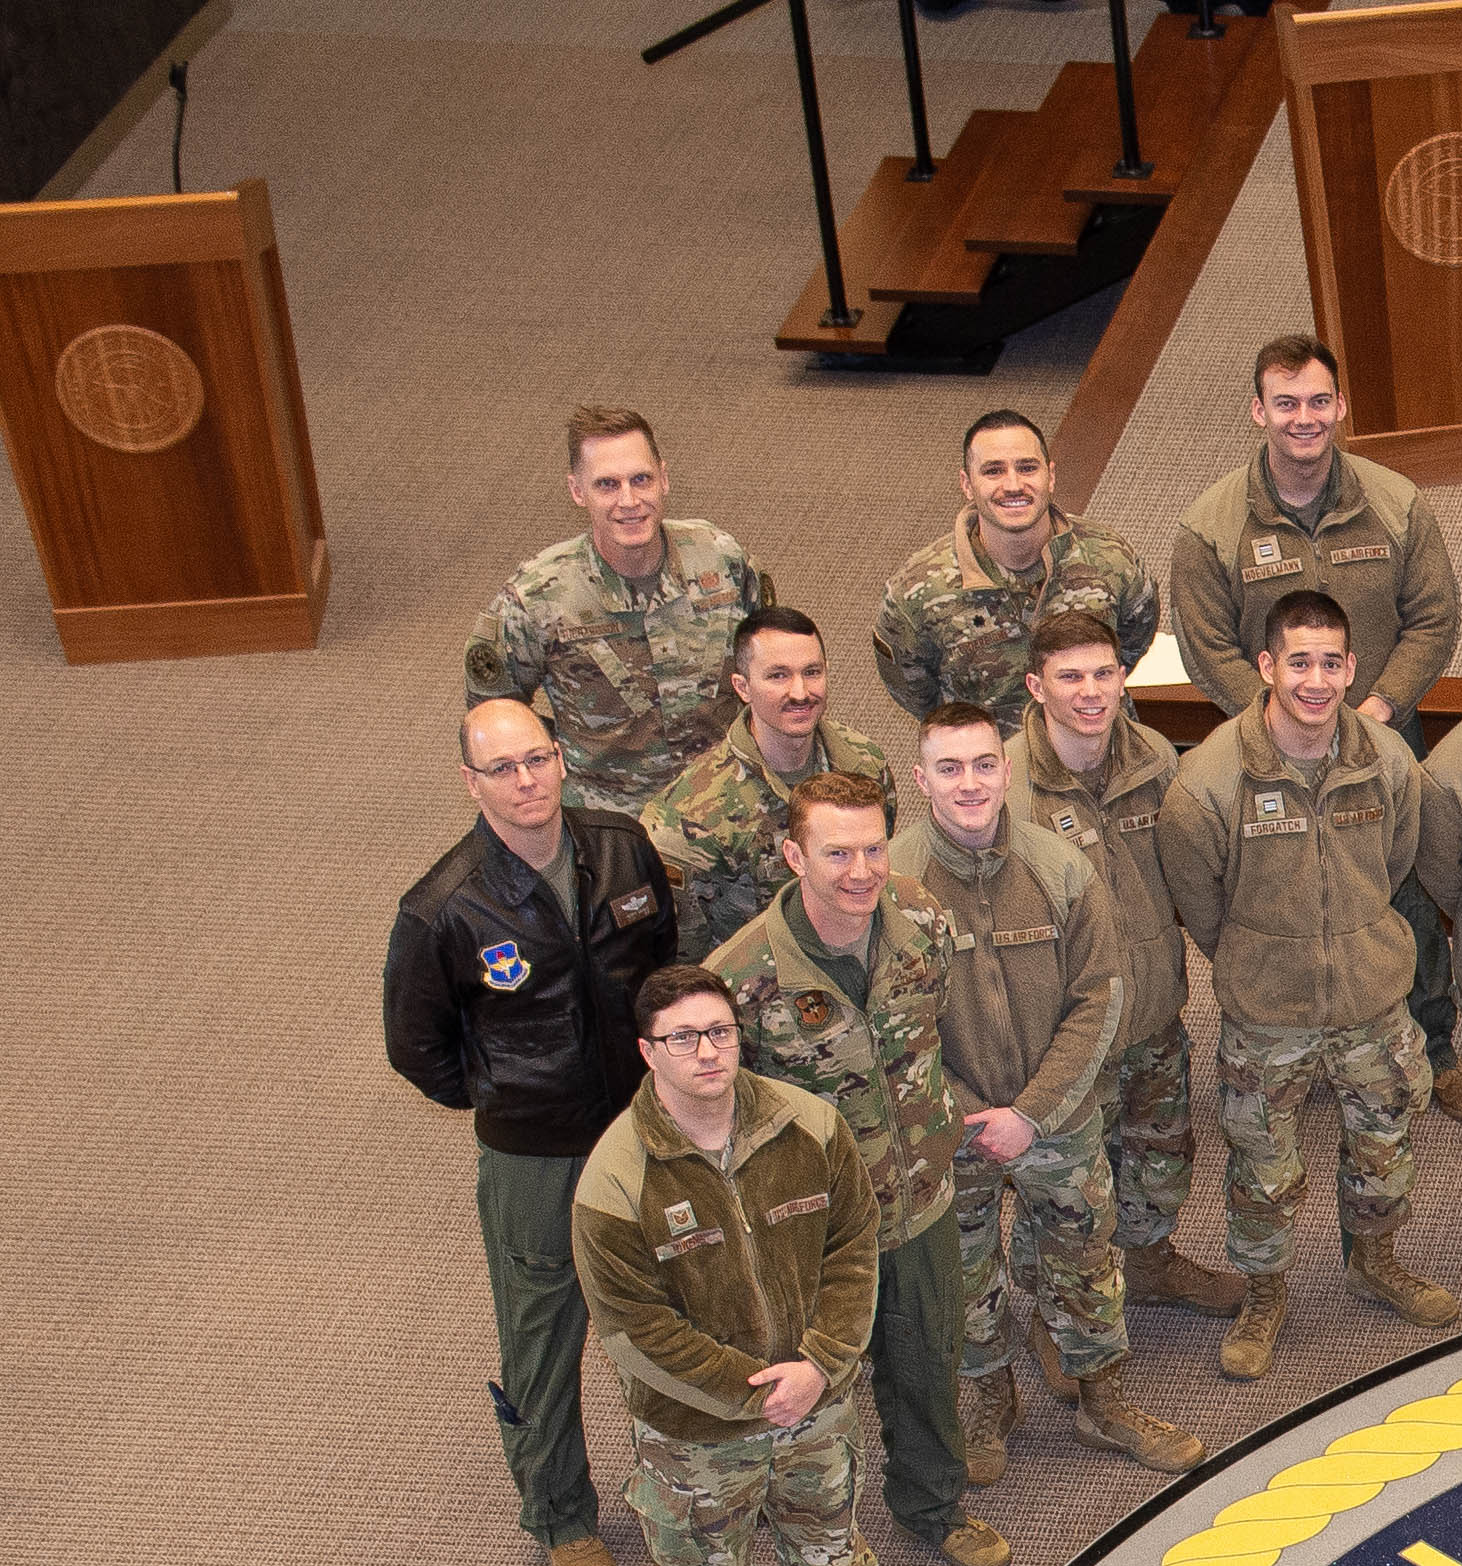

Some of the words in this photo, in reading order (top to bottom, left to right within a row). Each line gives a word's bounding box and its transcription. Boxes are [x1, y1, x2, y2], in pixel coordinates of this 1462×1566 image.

[1333, 553, 1348, 562] U.S.
[1350, 550, 1365, 560] AIR
[1366, 547, 1390, 559] FORCE
[995, 933, 1011, 944] U.S.
[1013, 932, 1027, 943] AIR
[1027, 928, 1055, 941] FORCE
